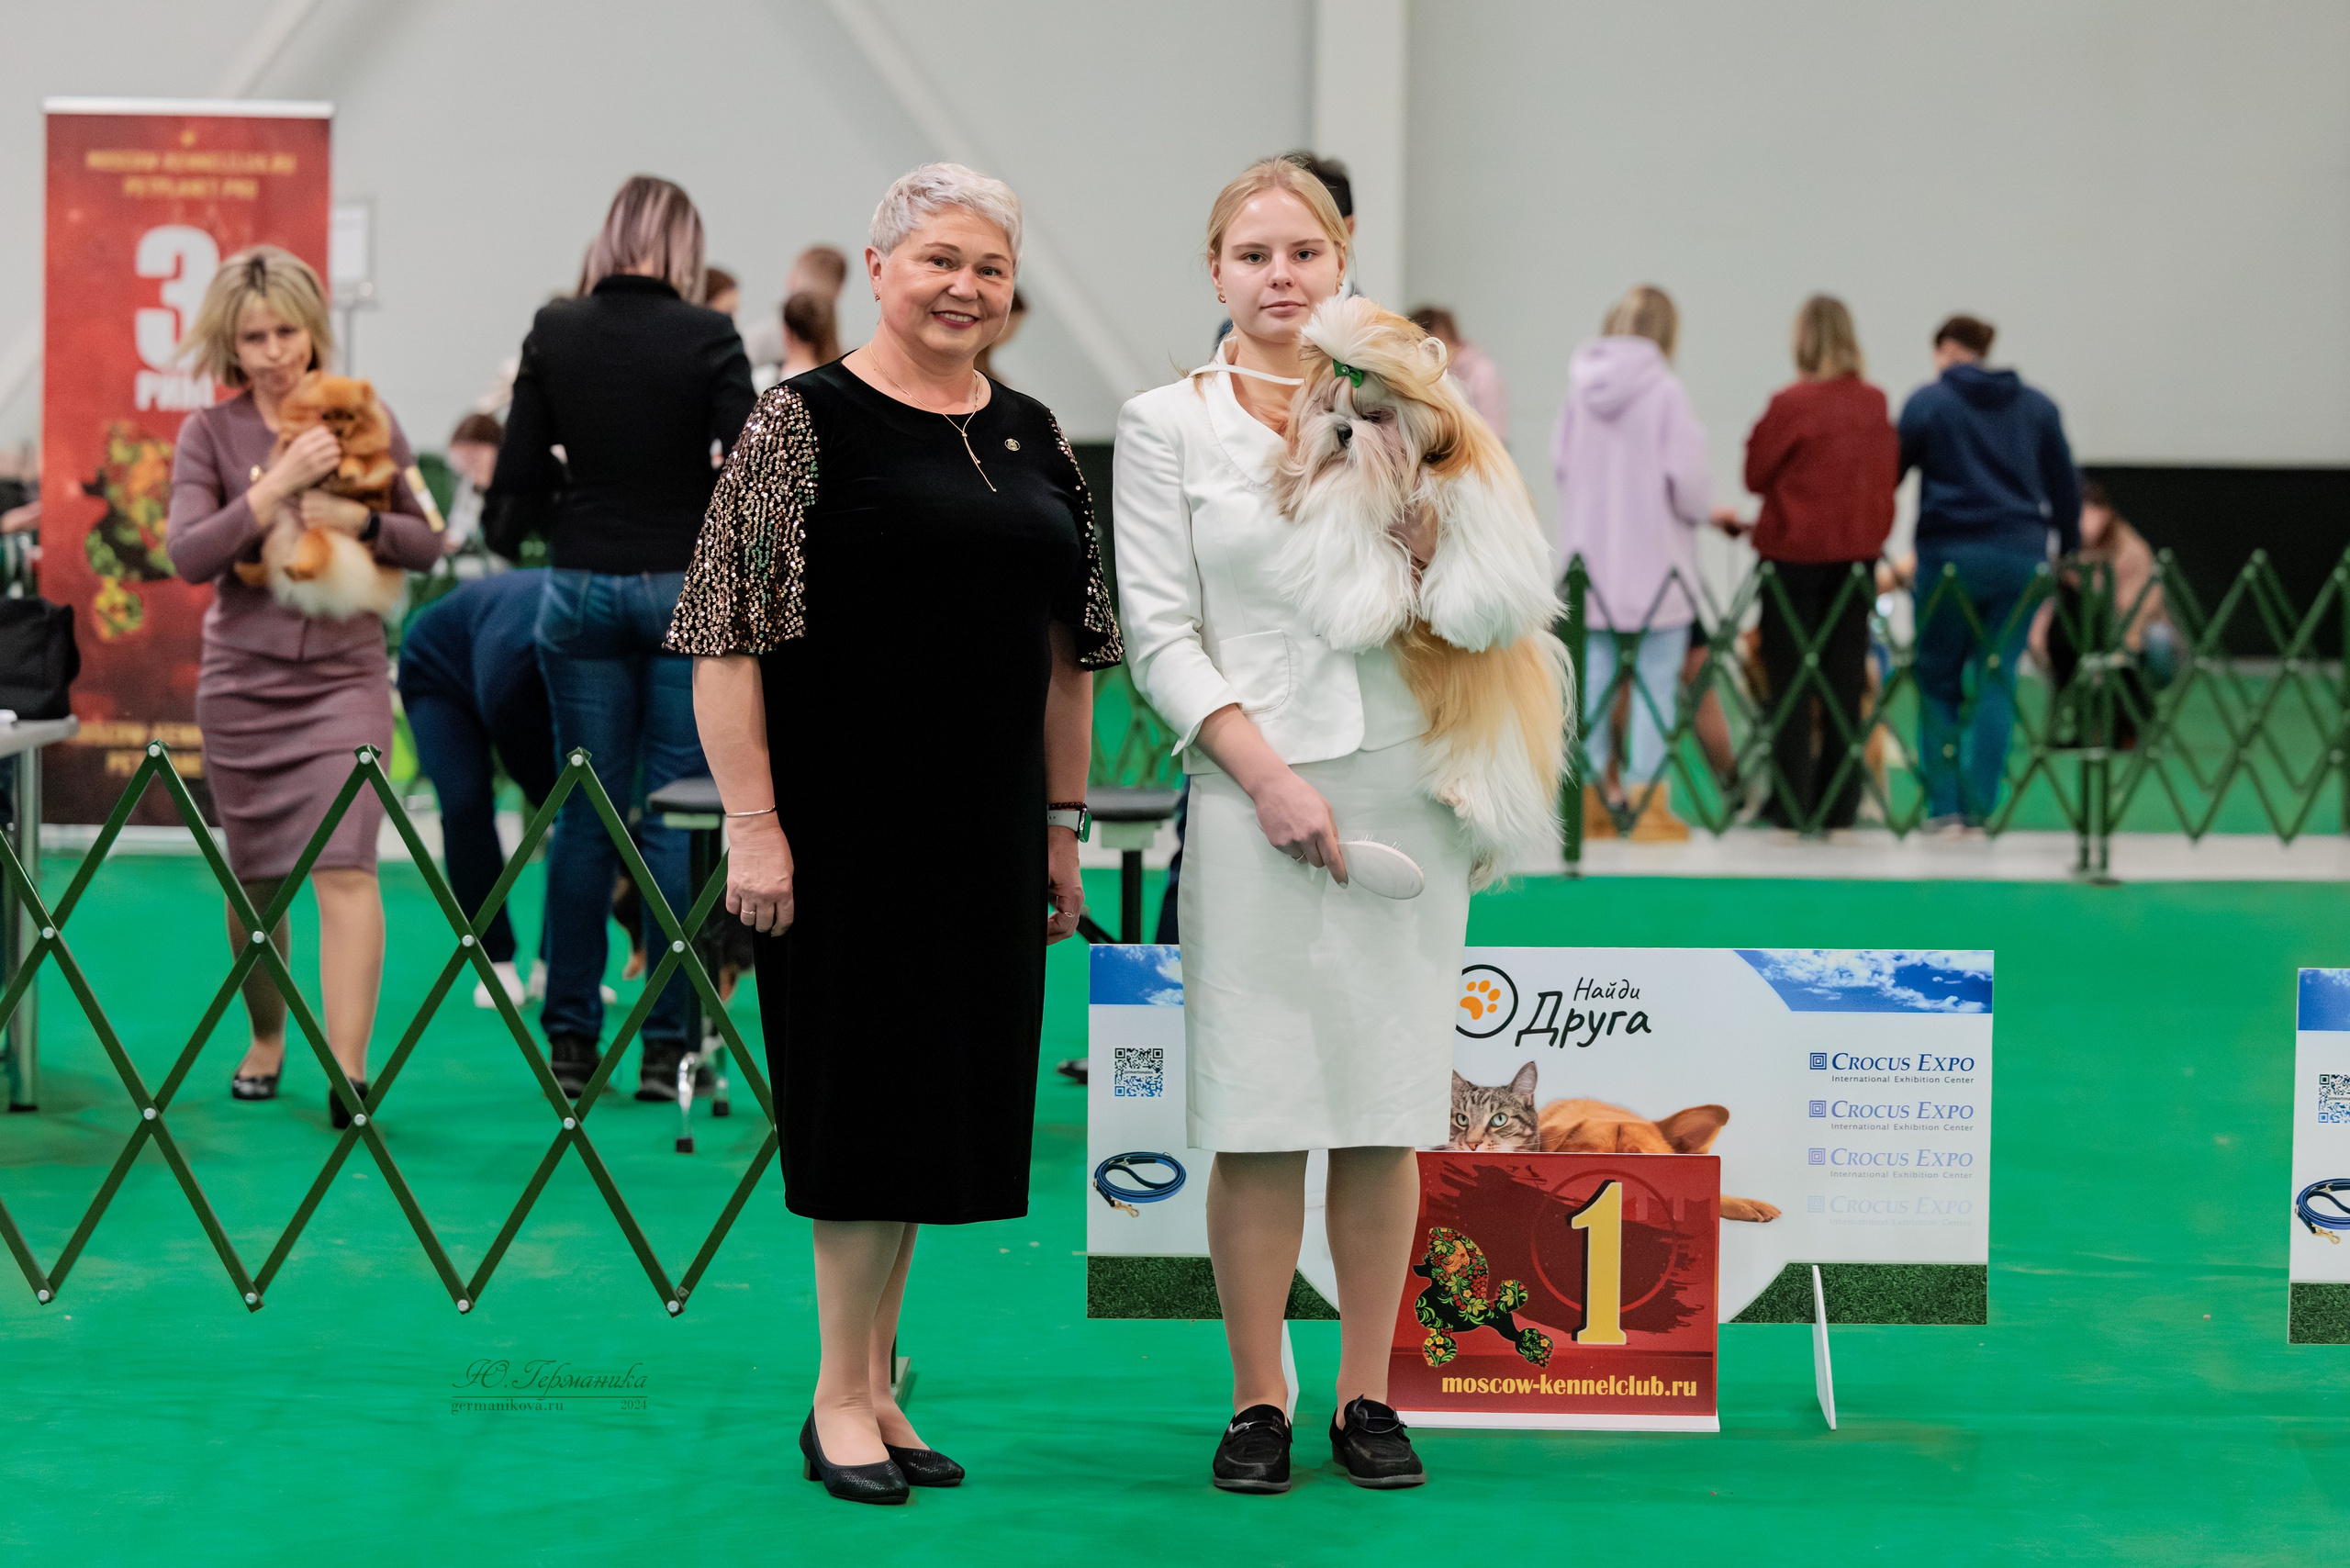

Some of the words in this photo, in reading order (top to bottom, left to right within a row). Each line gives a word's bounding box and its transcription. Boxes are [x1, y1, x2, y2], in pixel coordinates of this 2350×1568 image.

[135, 223, 219, 373] 3
[1573, 976, 1640, 1002] Найди
[1515, 991, 1651, 1048] Друга
[1831, 1052, 1911, 1071] CROCUS
[1917, 1053, 1975, 1071] EXPO
[1831, 1075, 1890, 1083] International
[1894, 1075, 1941, 1083] Exhibition
[1943, 1076, 1975, 1084] Center
[1830, 1100, 1910, 1119] CROCUS
[1916, 1101, 1974, 1119] EXPO
[1830, 1123, 1889, 1131] International
[1893, 1123, 1940, 1131] Exhibition
[1942, 1124, 1974, 1132] Center
[1830, 1148, 1909, 1167] CROCUS
[1915, 1148, 1973, 1167] EXPO
[1830, 1170, 1888, 1179] International
[1892, 1170, 1939, 1179] Exhibition
[1942, 1171, 1973, 1180] Center
[1566, 1179, 1628, 1345] 1
[1441, 1374, 1698, 1396] moscow-kennelclub.ru
